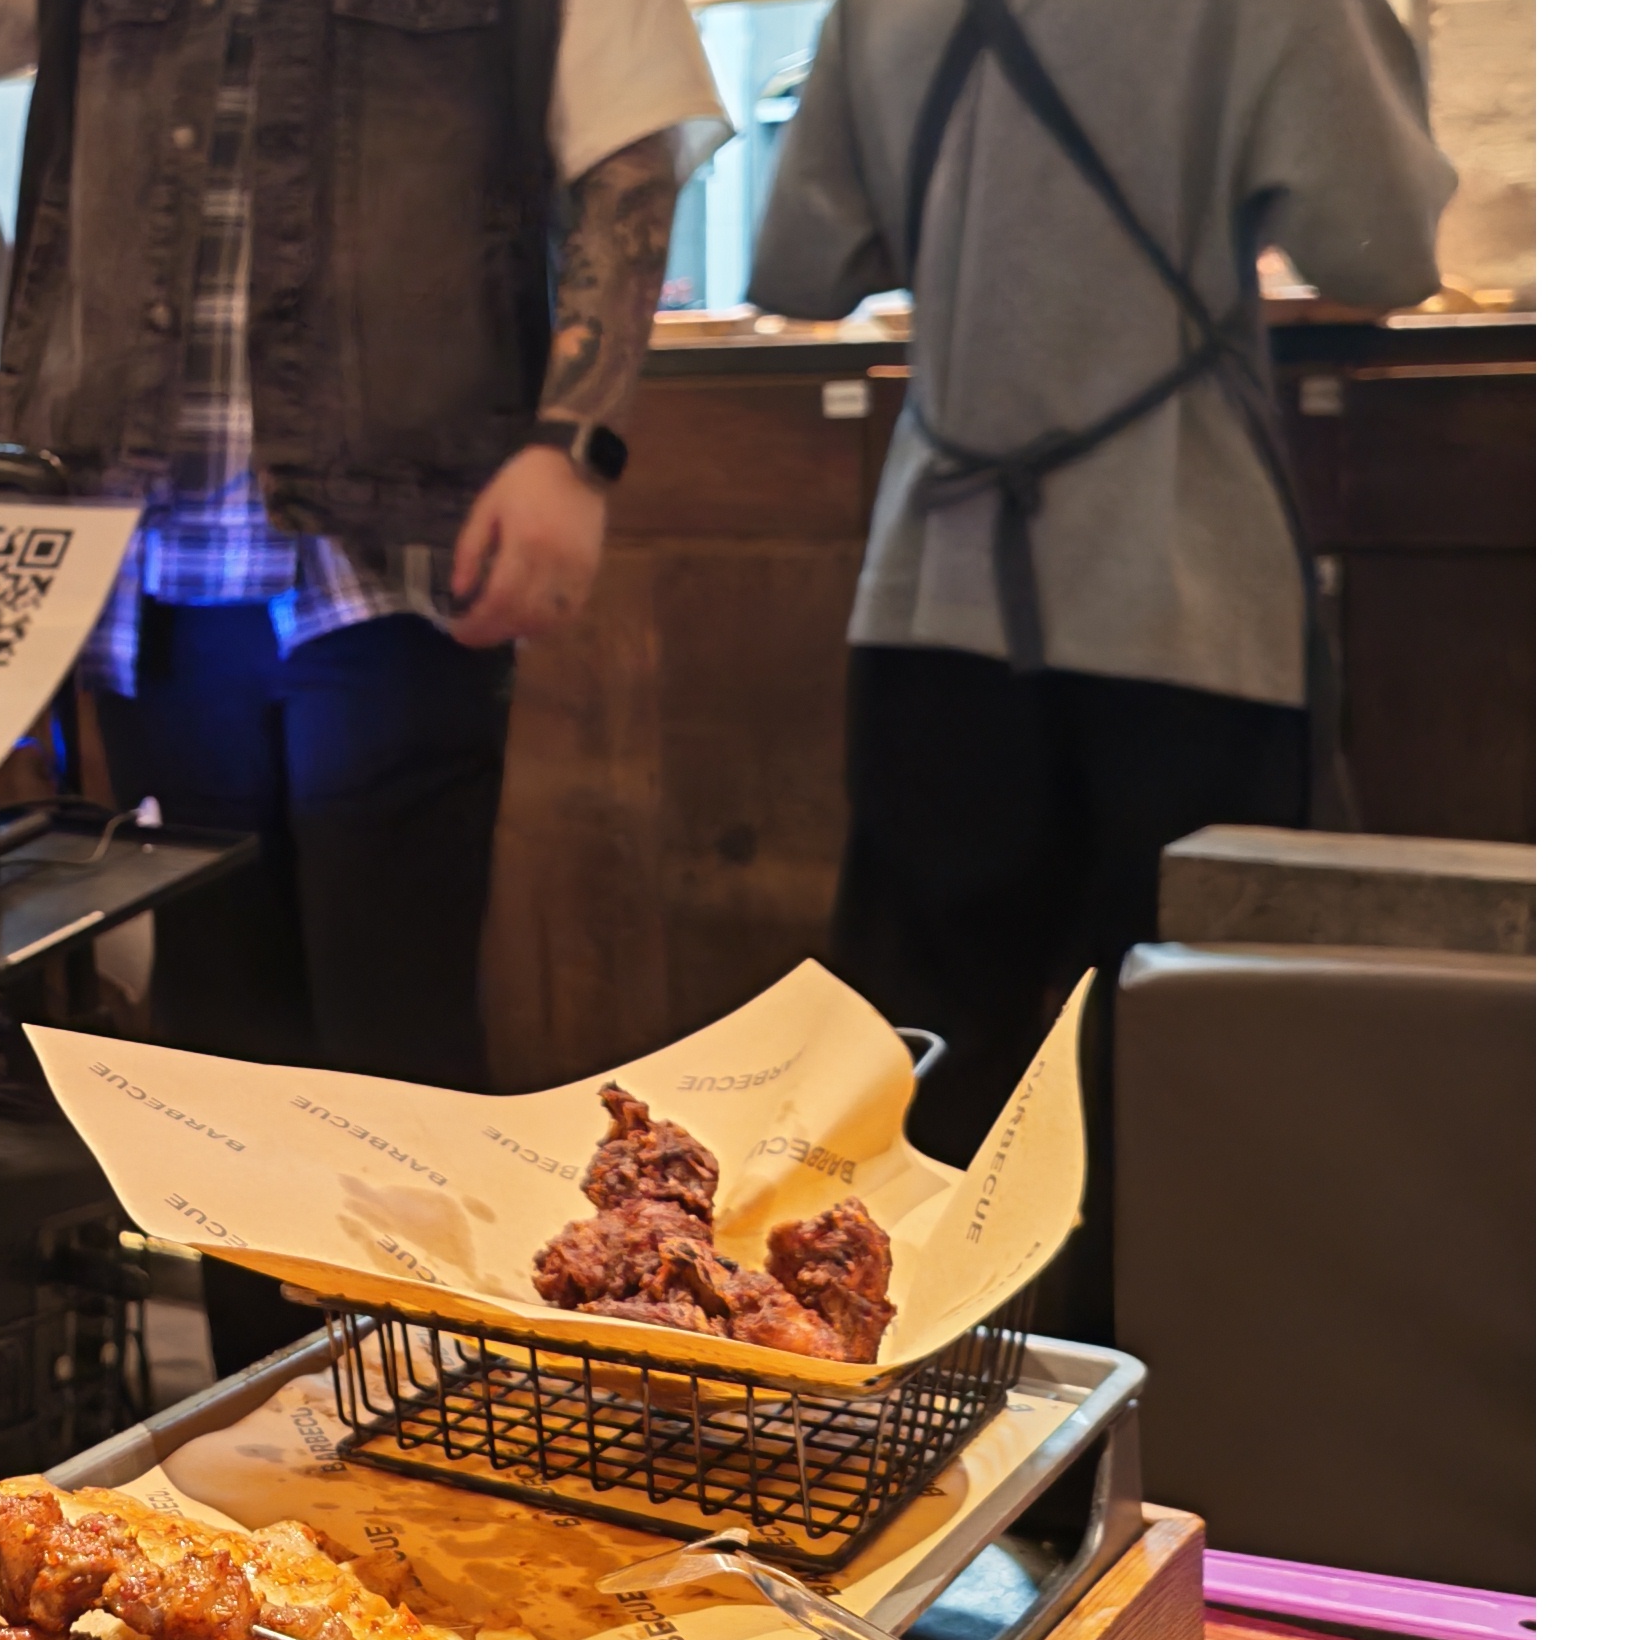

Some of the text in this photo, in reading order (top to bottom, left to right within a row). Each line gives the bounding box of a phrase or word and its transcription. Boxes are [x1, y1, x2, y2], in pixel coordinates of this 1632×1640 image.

[88, 1061, 248, 1153] BARBECUE
[290, 1094, 449, 1187] BARBECUE
[480, 1125, 581, 1181] BECUE
